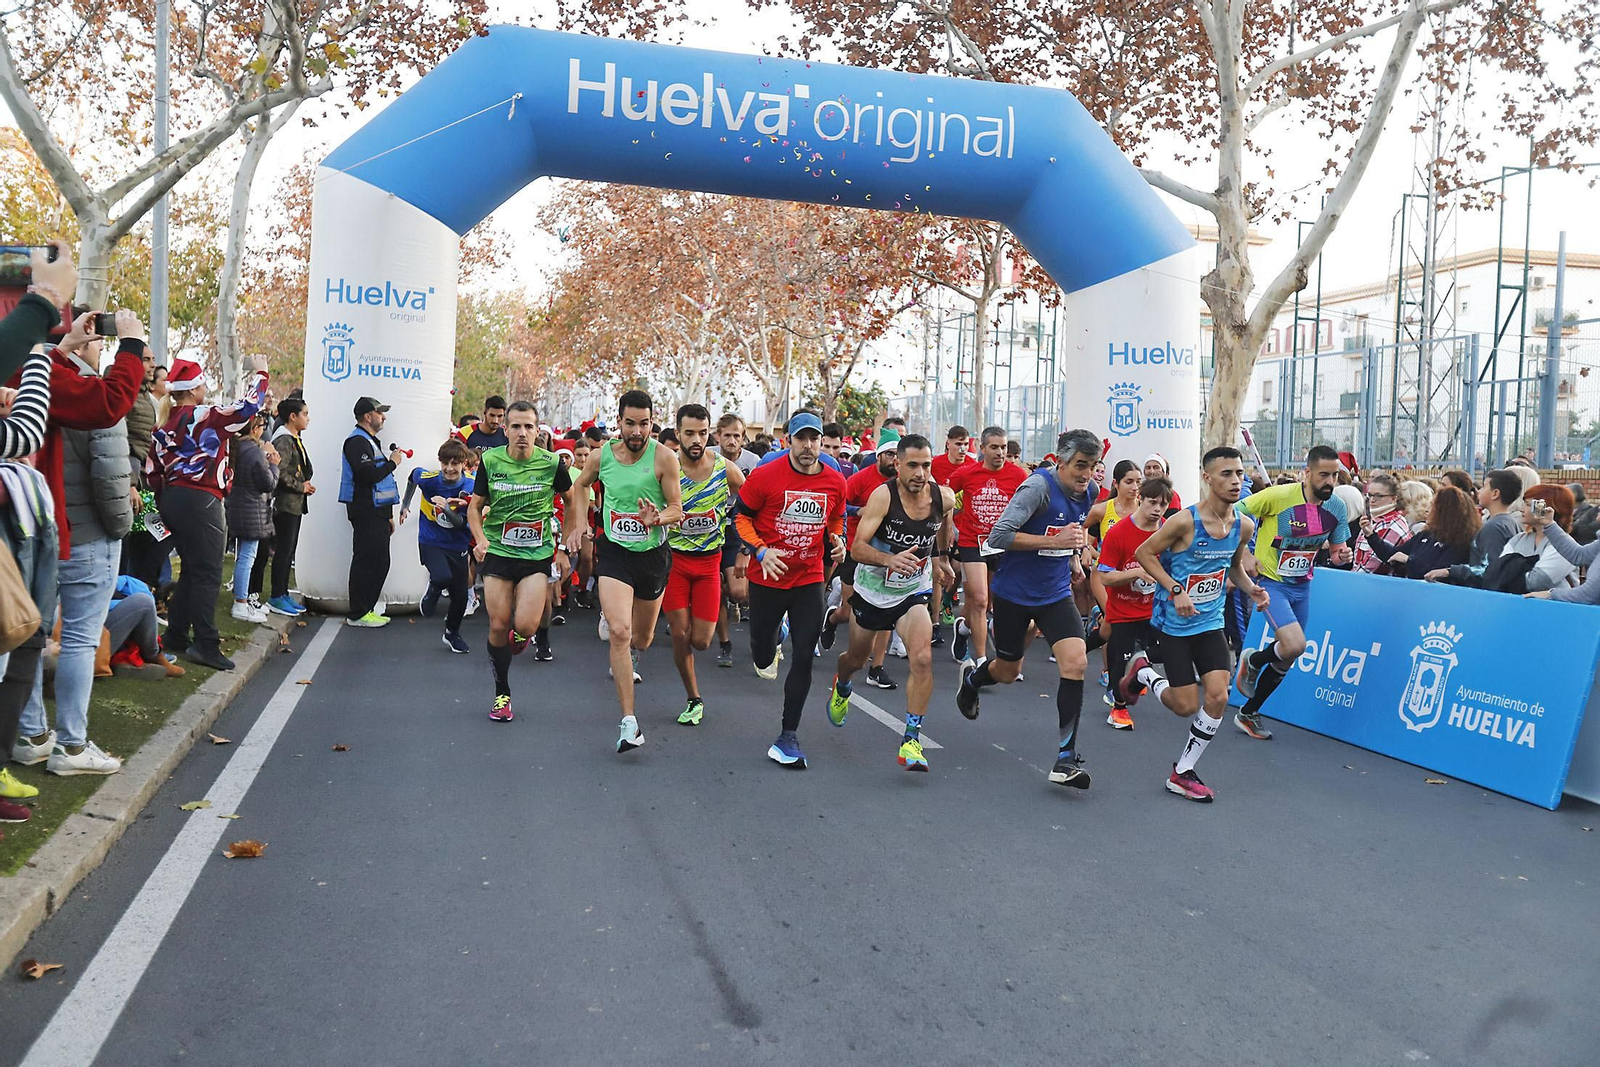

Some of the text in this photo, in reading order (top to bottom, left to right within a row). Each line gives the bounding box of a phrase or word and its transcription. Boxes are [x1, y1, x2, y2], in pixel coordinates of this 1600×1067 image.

[568, 58, 1014, 163] Huelva original
[326, 278, 426, 311] Huelva
[390, 312, 426, 323] original
[359, 354, 413, 365] Ayuntamiento
[1108, 341, 1194, 366] Huelva
[358, 364, 421, 380] HUELVA
[1147, 418, 1193, 429] HUELVA
[493, 482, 512, 492] MEDIO
[794, 500, 816, 514] 300
[616, 520, 638, 533] 463
[687, 517, 709, 529] 645
[513, 528, 534, 539] 123
[784, 535, 813, 547] 2023
[1288, 557, 1307, 569] 613
[1197, 579, 1218, 594] 629
[1315, 685, 1357, 708] original
[1455, 684, 1545, 717] Ayuntamiento de
[1447, 702, 1536, 749] HUELVA
